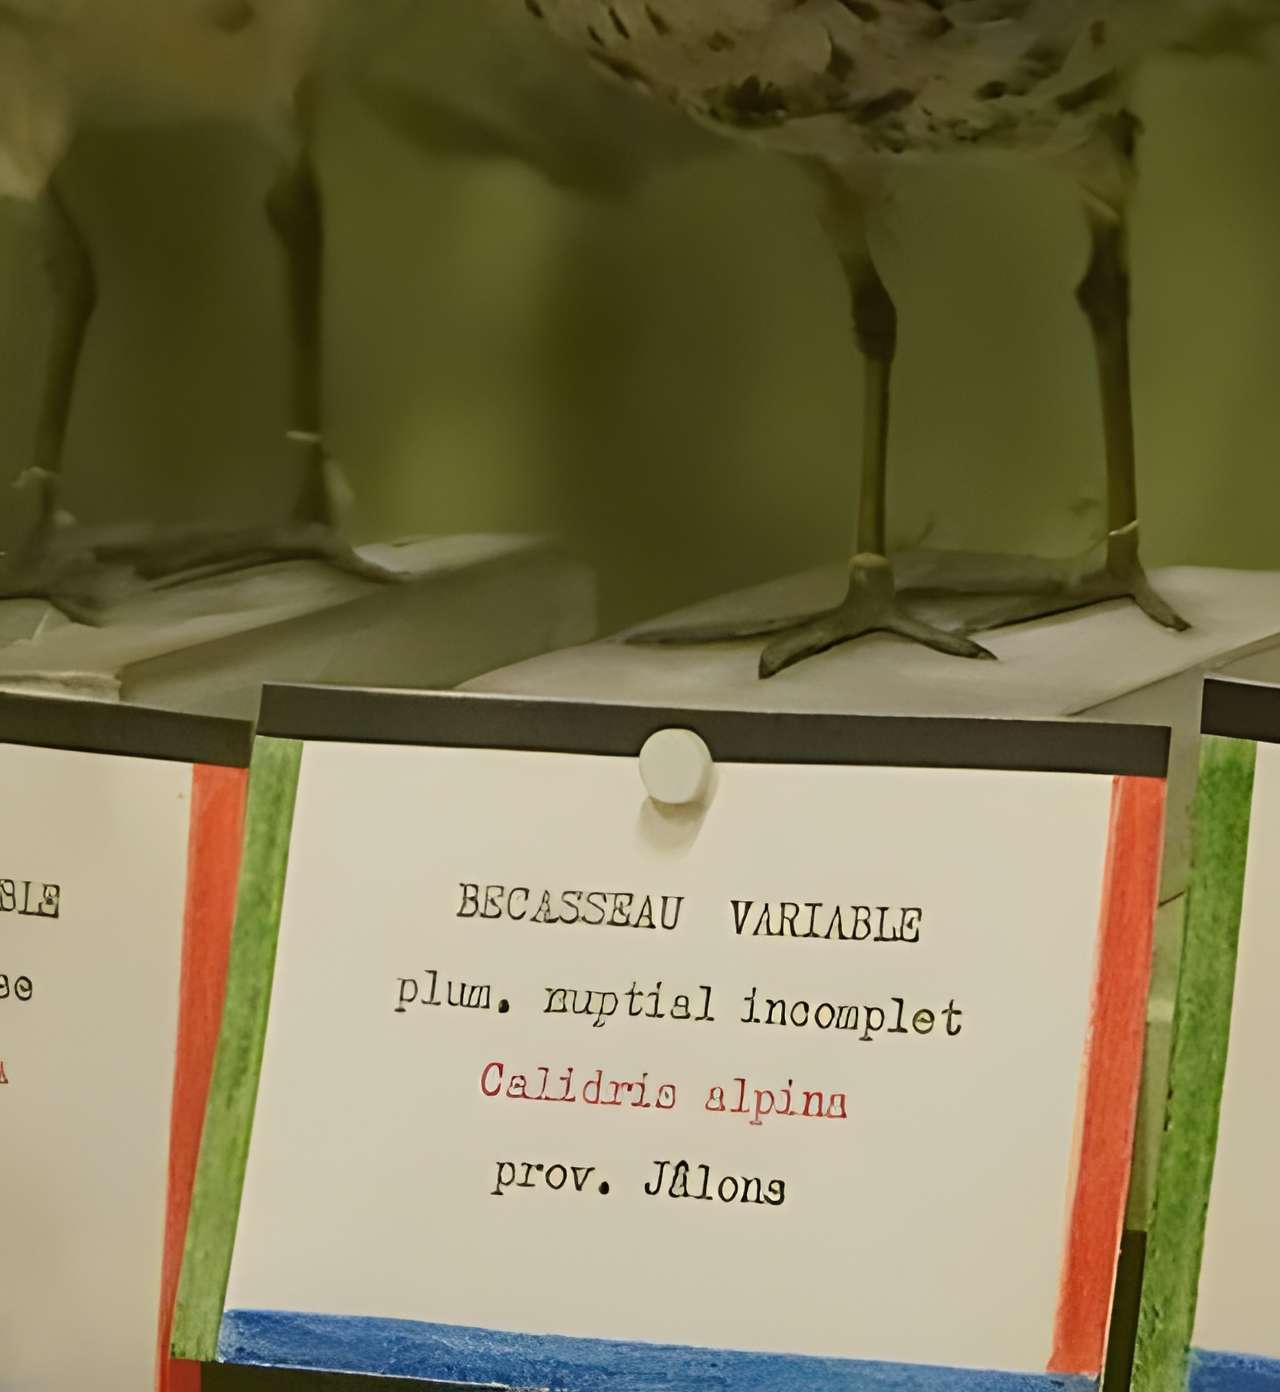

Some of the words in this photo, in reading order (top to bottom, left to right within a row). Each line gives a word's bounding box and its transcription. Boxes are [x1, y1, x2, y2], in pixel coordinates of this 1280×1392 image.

[456, 882, 685, 931] BECASSEAU
[729, 899, 923, 943] VARIABLE
[394, 969, 512, 1014] plum.
[543, 981, 716, 1028] nuptial
[739, 987, 964, 1041] incomplet
[480, 1062, 678, 1110] Calidris
[704, 1078, 849, 1126] alpina
[490, 1158, 611, 1197] prov.
